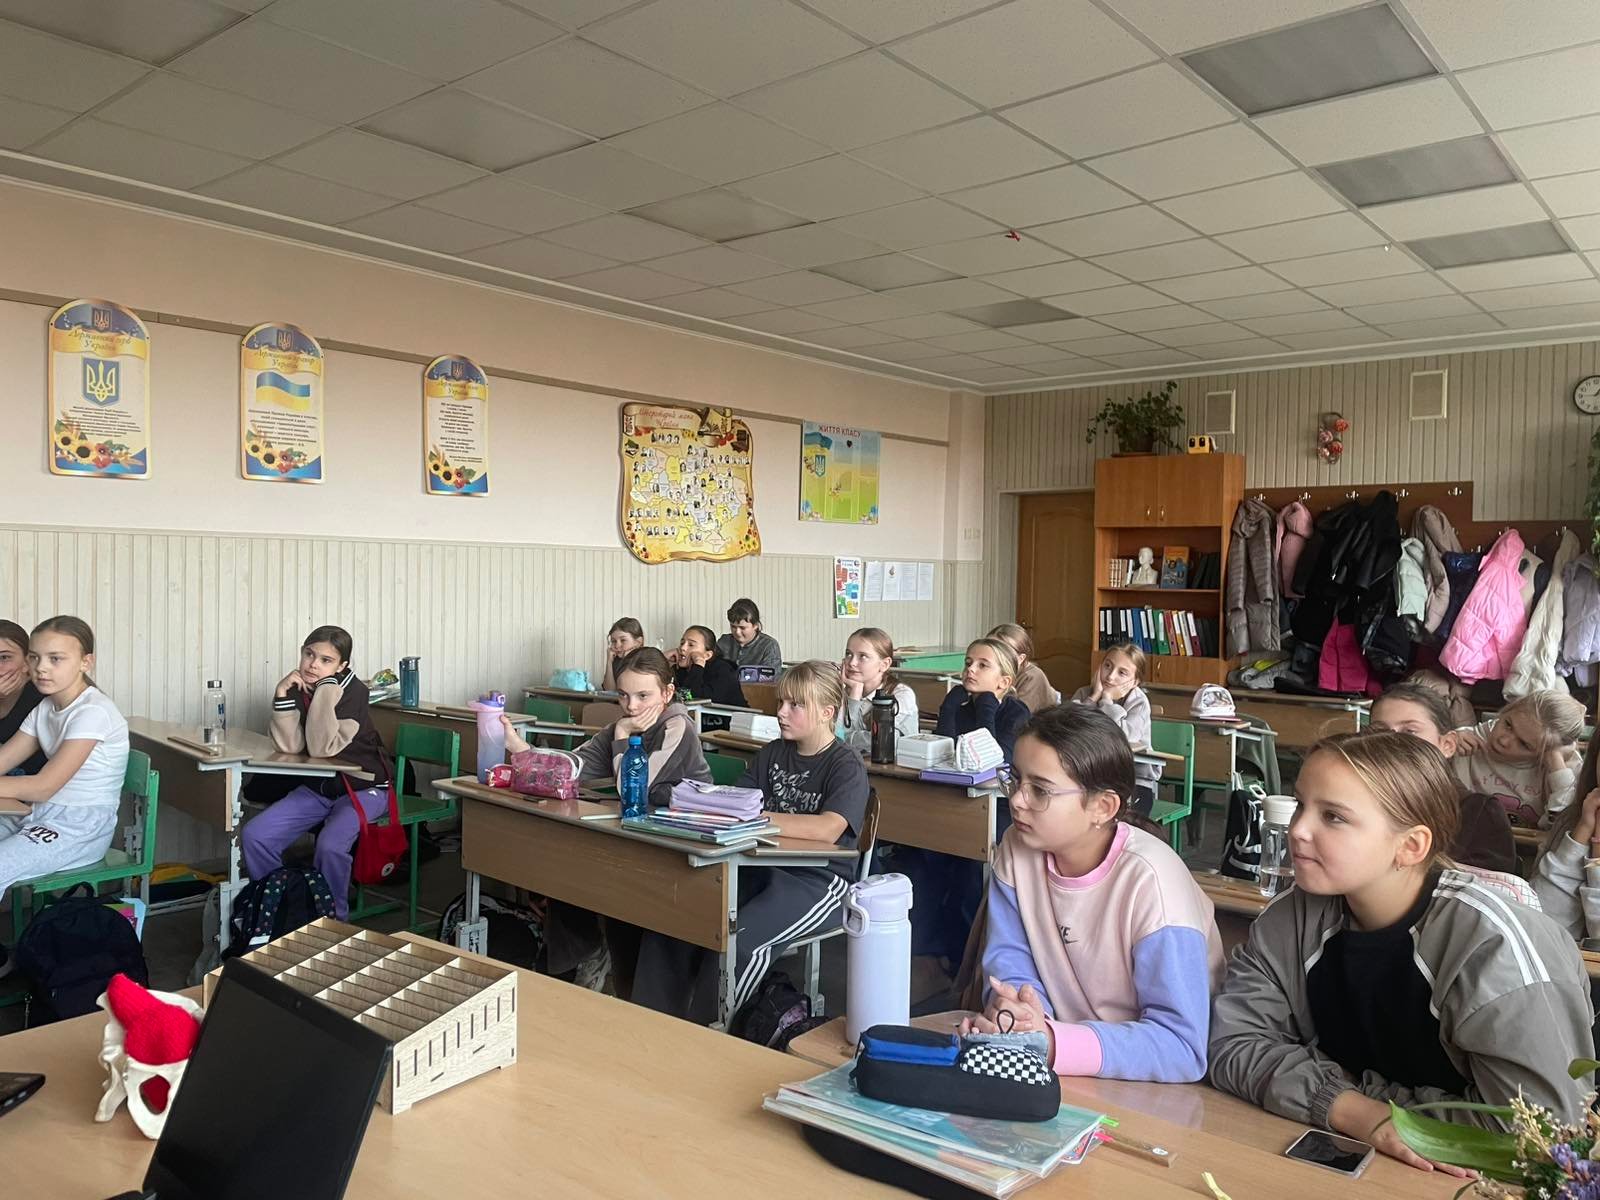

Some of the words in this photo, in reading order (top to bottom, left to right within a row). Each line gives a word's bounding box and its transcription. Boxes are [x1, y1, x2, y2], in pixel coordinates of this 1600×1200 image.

[818, 425, 840, 435] ЖИТТЯ
[841, 428, 861, 438] КЛАСУ
[773, 782, 822, 812] energy
